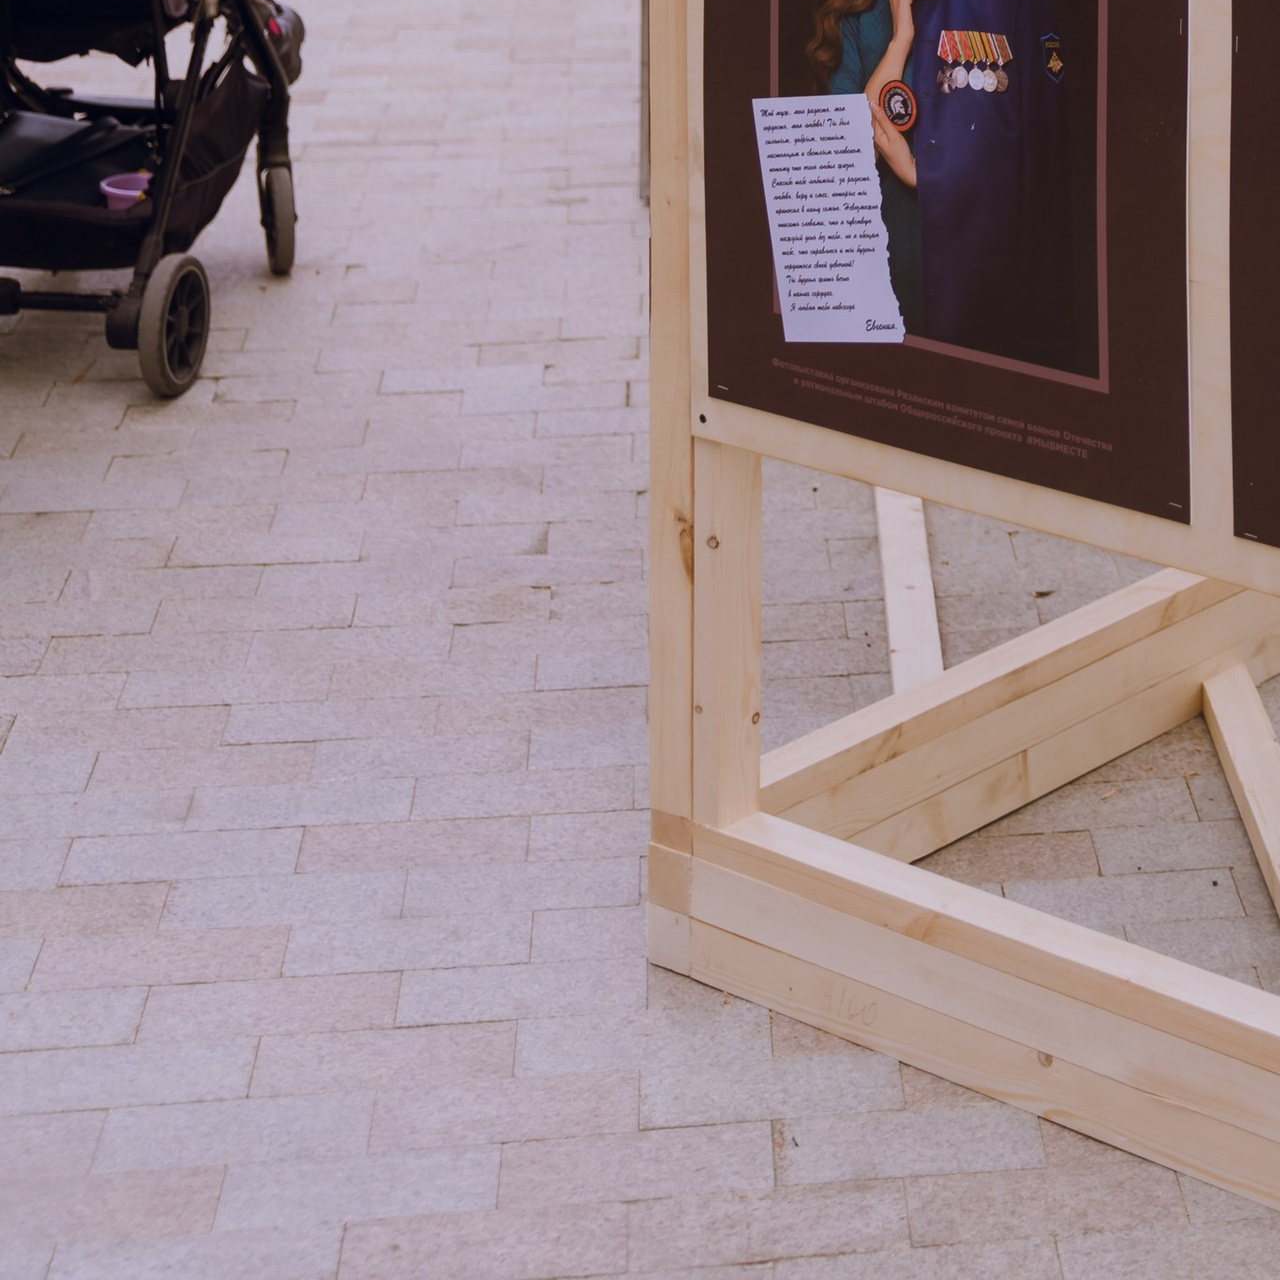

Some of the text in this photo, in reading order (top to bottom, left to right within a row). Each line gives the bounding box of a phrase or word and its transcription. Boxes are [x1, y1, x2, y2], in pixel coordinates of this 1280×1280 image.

[771, 357, 1113, 452] Фотовыставка организована Рязанским комитетом семей воинов Отечества
[792, 377, 799, 385] и
[800, 378, 863, 402] региональным
[863, 395, 898, 411] штабом
[899, 403, 983, 432] Общероссийского
[984, 425, 1023, 442] проекта
